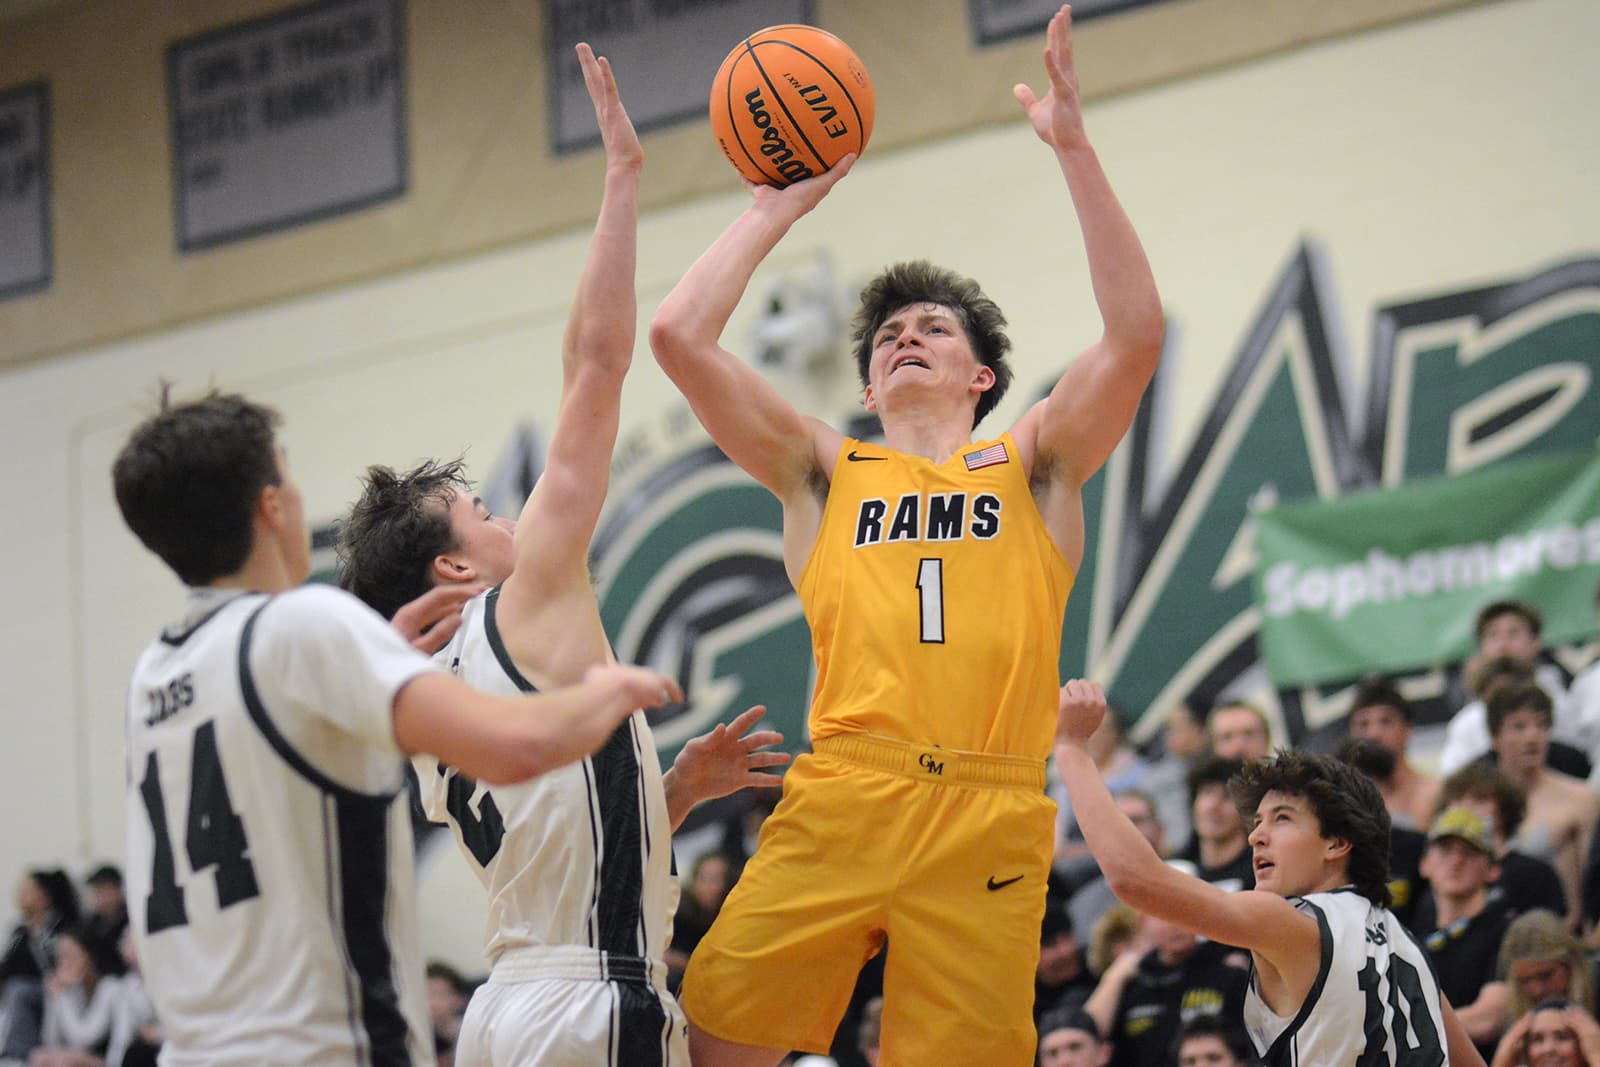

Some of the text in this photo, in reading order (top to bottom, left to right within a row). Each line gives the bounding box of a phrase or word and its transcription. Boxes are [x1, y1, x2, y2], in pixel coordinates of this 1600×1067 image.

[745, 87, 814, 184] Wilson
[853, 492, 1002, 549] RAMS
[915, 557, 945, 644] 1
[139, 718, 261, 935] 14
[1355, 951, 1446, 1067] 10
